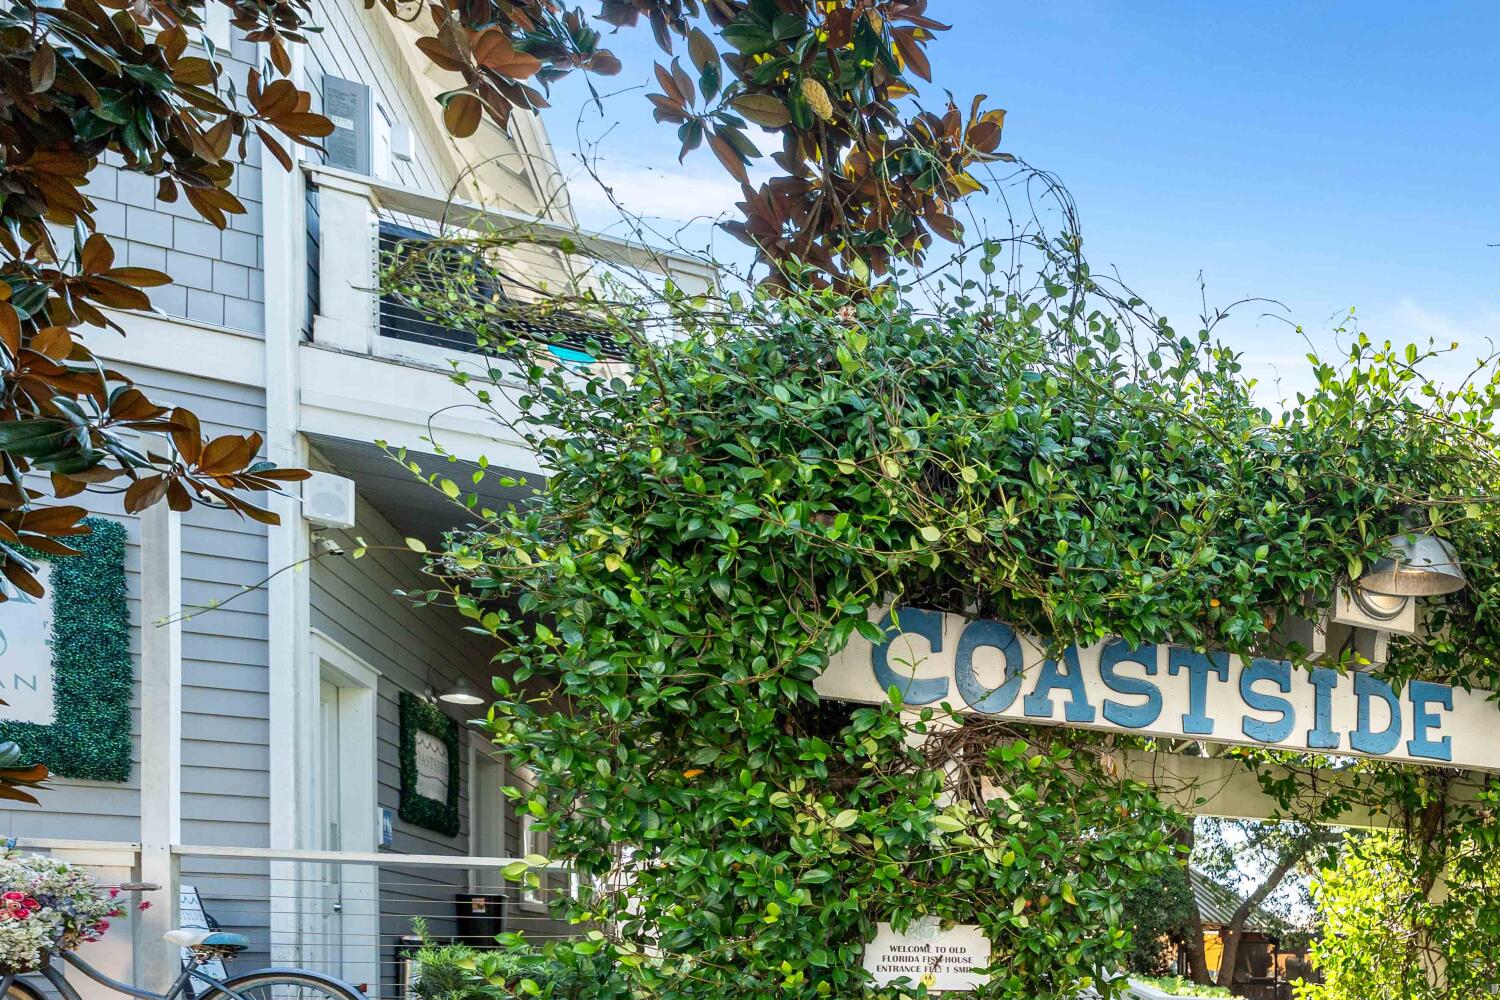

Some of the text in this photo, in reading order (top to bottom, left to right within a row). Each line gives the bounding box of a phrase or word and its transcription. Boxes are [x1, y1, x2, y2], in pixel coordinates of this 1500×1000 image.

[872, 607, 1453, 762] COASTSIDE
[889, 945, 966, 954] WELCOME TO OLD
[882, 955, 920, 963] FLORIDA
[945, 956, 973, 964] HOUSE
[876, 964, 922, 973] ENTRANCE
